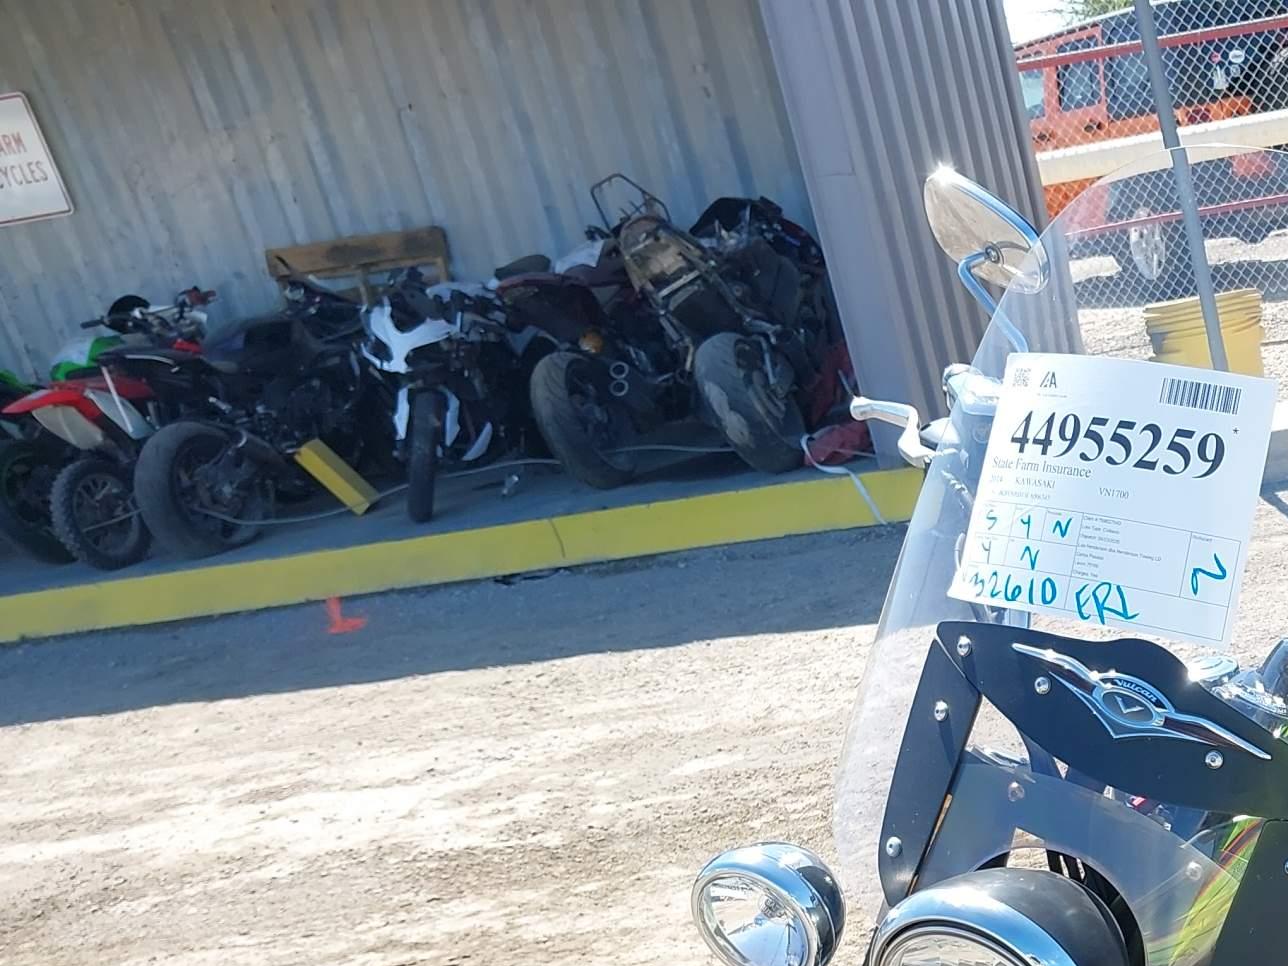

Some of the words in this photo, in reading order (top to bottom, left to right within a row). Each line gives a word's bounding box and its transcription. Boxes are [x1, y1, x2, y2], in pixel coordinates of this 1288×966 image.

[0, 161, 49, 188] YCLES
[1011, 411, 1225, 479] 44955259
[992, 456, 1013, 469] State
[1015, 459, 1039, 472] Farm
[1042, 460, 1092, 478] Insurance
[1015, 476, 1056, 489] KAWASAKI
[1099, 487, 1130, 500] VN1700
[1113, 678, 1158, 703] Vulcan
